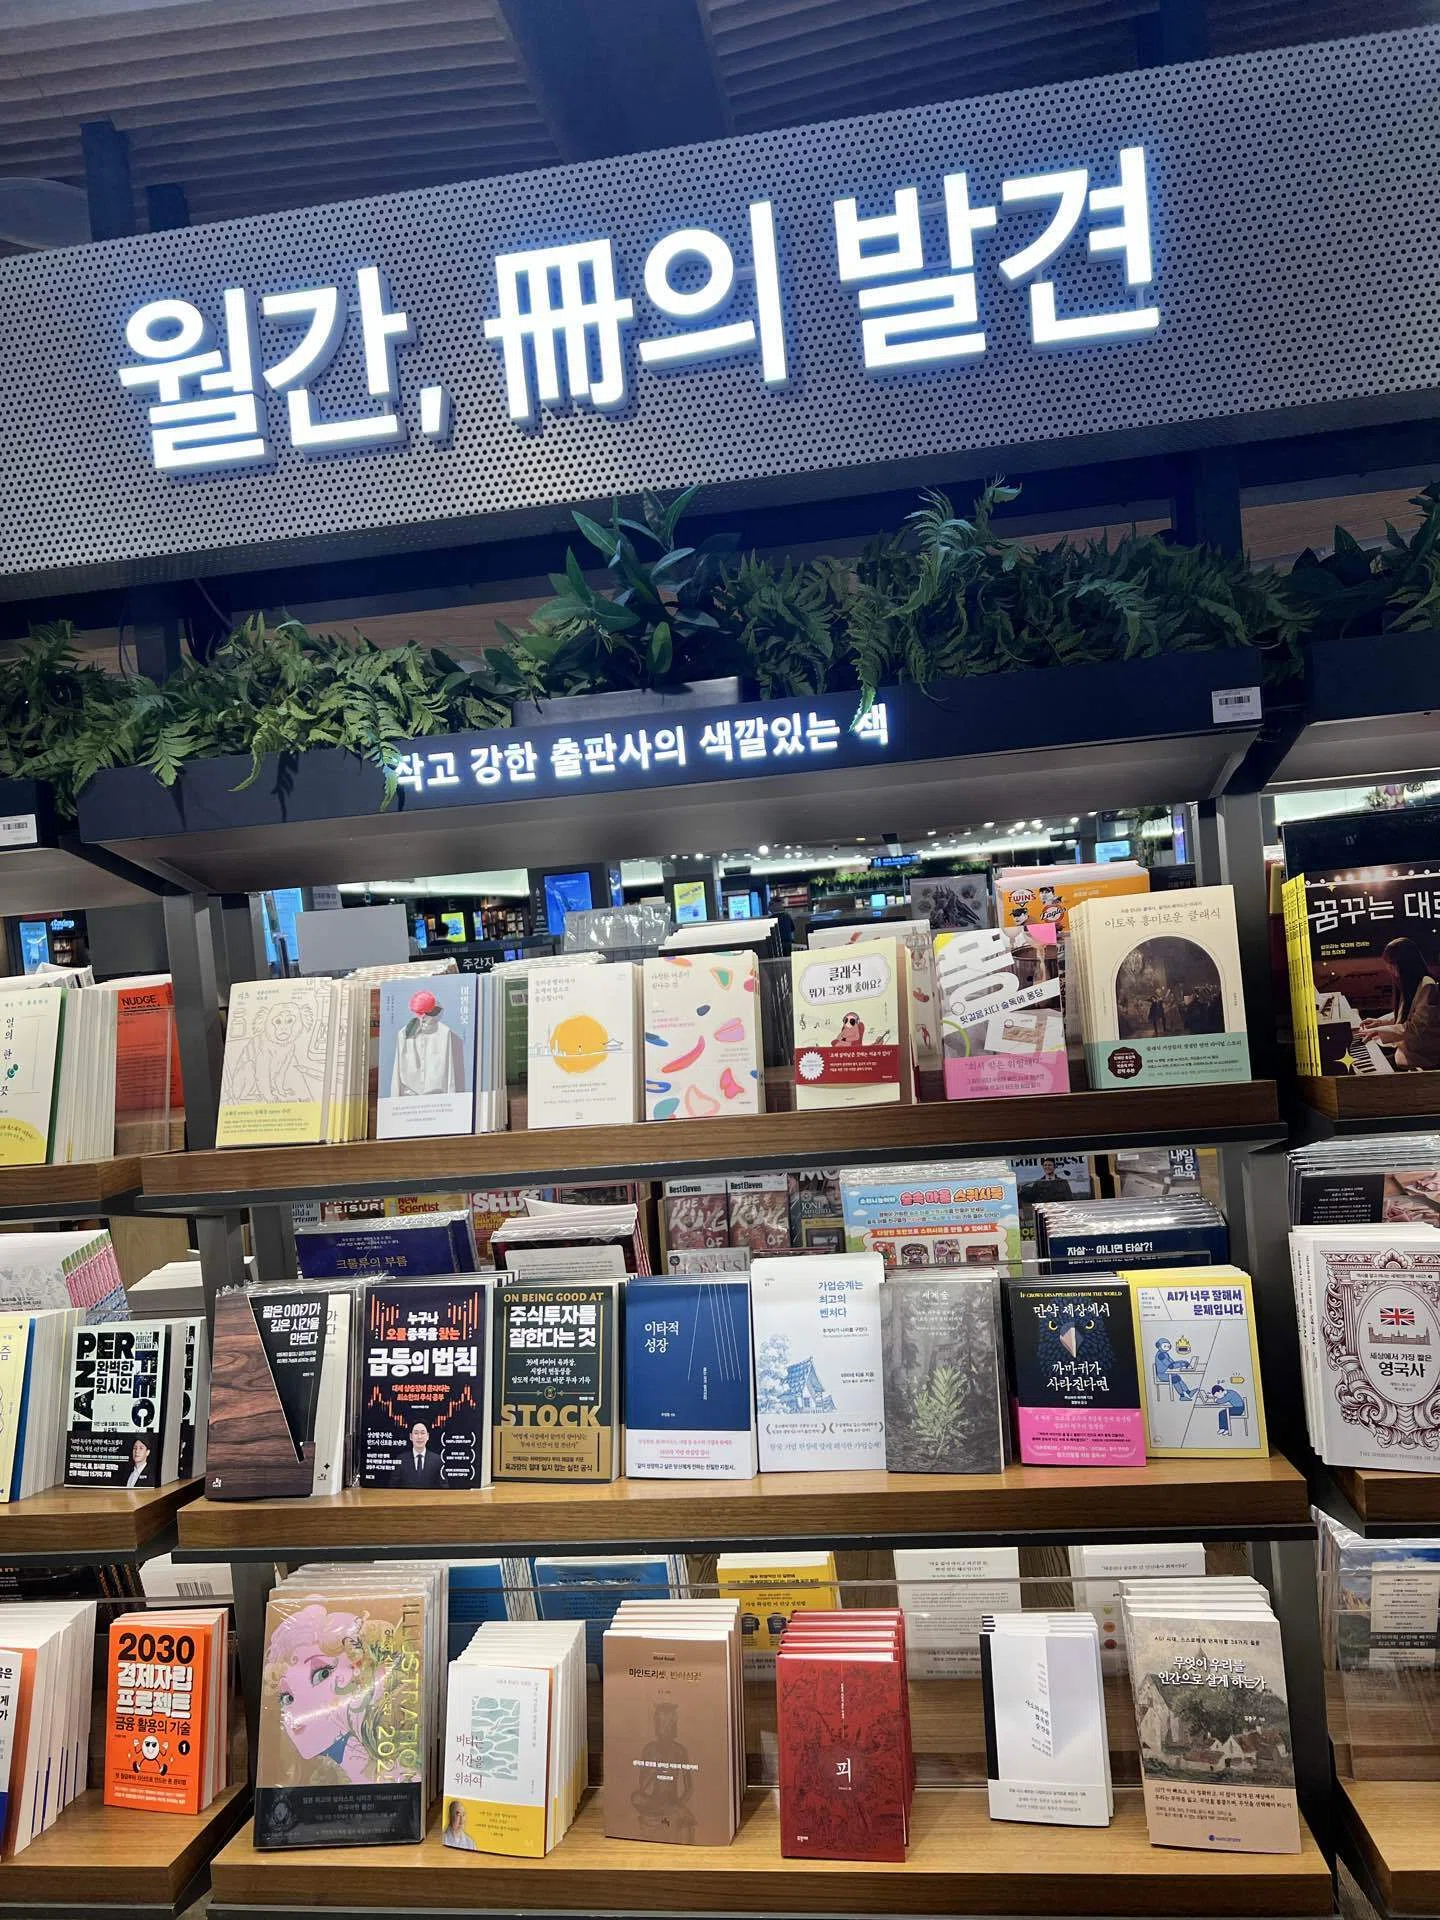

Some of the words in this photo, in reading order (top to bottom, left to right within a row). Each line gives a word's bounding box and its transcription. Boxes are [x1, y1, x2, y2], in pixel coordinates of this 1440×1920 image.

[118, 266, 448, 470] 월간,
[484, 199, 786, 418] 冊의
[832, 145, 1160, 370] 발견
[470, 740, 537, 783] 강한
[551, 725, 687, 778] 출판사의
[700, 711, 840, 762] 색깔있는
[1104, 917, 1136, 928] 이토록
[1142, 912, 1183, 927] 흥미로운
[1188, 908, 1220, 921] 클래식
[1308, 896, 1394, 934] 꿈꾸는
[1404, 891, 1440, 920] 대
[462, 956, 495, 968] 주간지
[828, 963, 862, 982] 클래식
[808, 986, 826, 998] 뭐가
[828, 983, 852, 997] 그렇게
[854, 978, 881, 993] 좋아요?
[122, 994, 156, 1006] NUDGE
[960, 1004, 1000, 1024] 뒷걸음치다
[1001, 995, 1026, 1009] 술독에
[1027, 988, 1044, 1001] 풍덩
[1170, 1149, 1193, 1164] 내일
[1172, 1165, 1195, 1180] 교육
[399, 1201, 440, 1214] Scientist
[1096, 1245, 1123, 1254] 아니면
[385, 1256, 408, 1267] 부름
[818, 1281, 863, 1291] 가업승계는
[503, 1294, 520, 1303] ON
[522, 1293, 554, 1302] BEING
[557, 1293, 586, 1302] GOOD
[589, 1292, 604, 1301] AT
[819, 1295, 846, 1304] 최고의
[1167, 1291, 1188, 1301] AI가
[1190, 1290, 1210, 1301] 너무
[1211, 1289, 1242, 1301] 잘해서
[263, 1305, 283, 1318] 짧은
[284, 1303, 321, 1317] 이야기가
[509, 1304, 597, 1326] 주식투자를
[820, 1308, 847, 1318] 벤처다
[1033, 1304, 1059, 1318] 만약
[1062, 1303, 1110, 1318] 세상에서
[1193, 1304, 1244, 1315] 문제입니다
[271, 1319, 291, 1332] 깊은
[291, 1317, 320, 1331] 시간을
[408, 1311, 439, 1325] 누구나
[386, 1328, 407, 1340] 오를
[407, 1328, 438, 1341] 종목을
[439, 1327, 460, 1340] 찾는
[644, 1320, 680, 1336] 이타적
[290, 1332, 318, 1345] 만든다
[509, 1327, 575, 1348] 잘한다는
[579, 1327, 596, 1348] 것
[644, 1337, 668, 1353] 성장
[368, 1347, 429, 1377] 급등의
[432, 1347, 477, 1376] 법칙
[1370, 1352, 1398, 1360] 세상에서
[1417, 1354, 1432, 1362] 짧은
[96, 1361, 134, 1377] 완벽한
[1052, 1361, 1102, 1376] 까마귀가
[1379, 1361, 1426, 1378] 영국사
[96, 1378, 132, 1394] 원시인
[1046, 1377, 1110, 1393] 사라진다면
[500, 1405, 601, 1427] STOCK
[118, 1632, 196, 1664] 2030
[1174, 1656, 1206, 1672] 무엇이
[1210, 1658, 1246, 1673] 우리를
[117, 1662, 194, 1692] 경제자립
[1158, 1671, 1204, 1686] 인간으로
[1206, 1675, 1229, 1688] 살게
[1230, 1676, 1266, 1690] 하는가
[115, 1690, 192, 1720] 프로젝트
[115, 1717, 136, 1732] 금융
[137, 1717, 168, 1735] 활용의
[170, 1720, 191, 1736] 기술
[456, 1735, 484, 1750] 버티는
[455, 1753, 484, 1769] 시간을
[834, 1757, 852, 1783] 피
[455, 1773, 483, 1788] 위하여
